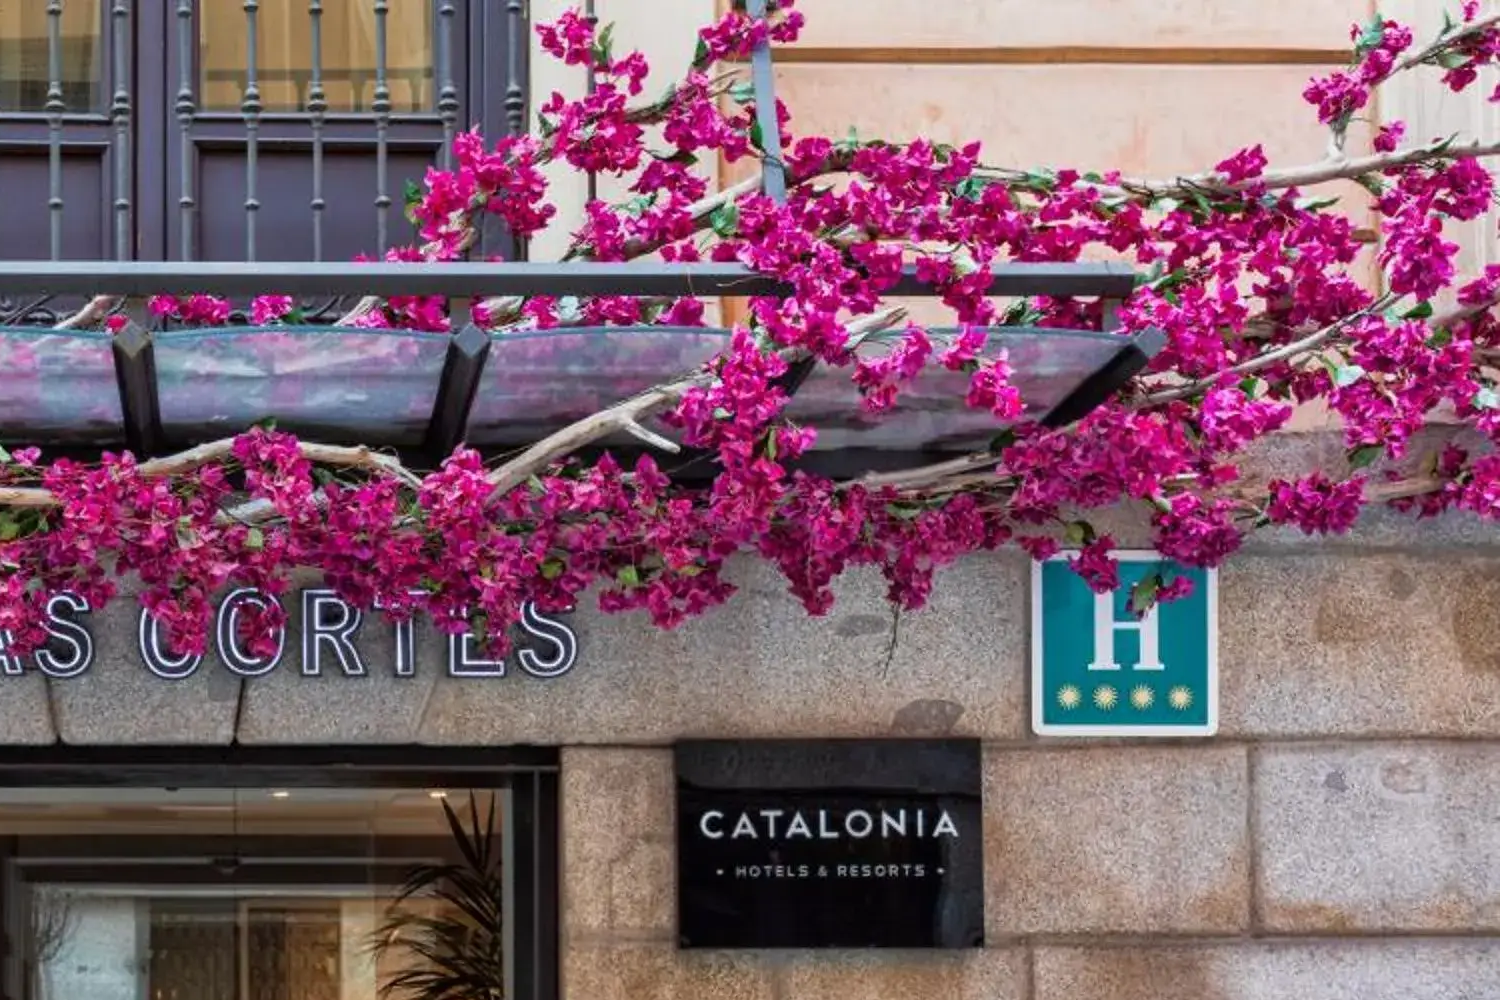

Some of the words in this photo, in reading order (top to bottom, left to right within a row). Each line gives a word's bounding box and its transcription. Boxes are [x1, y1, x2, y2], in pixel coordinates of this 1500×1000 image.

[1087, 582, 1165, 671] H
[700, 809, 959, 839] CATALONIA
[735, 864, 809, 878] HOTELS
[816, 864, 828, 878] &
[837, 864, 925, 878] RESORTS
